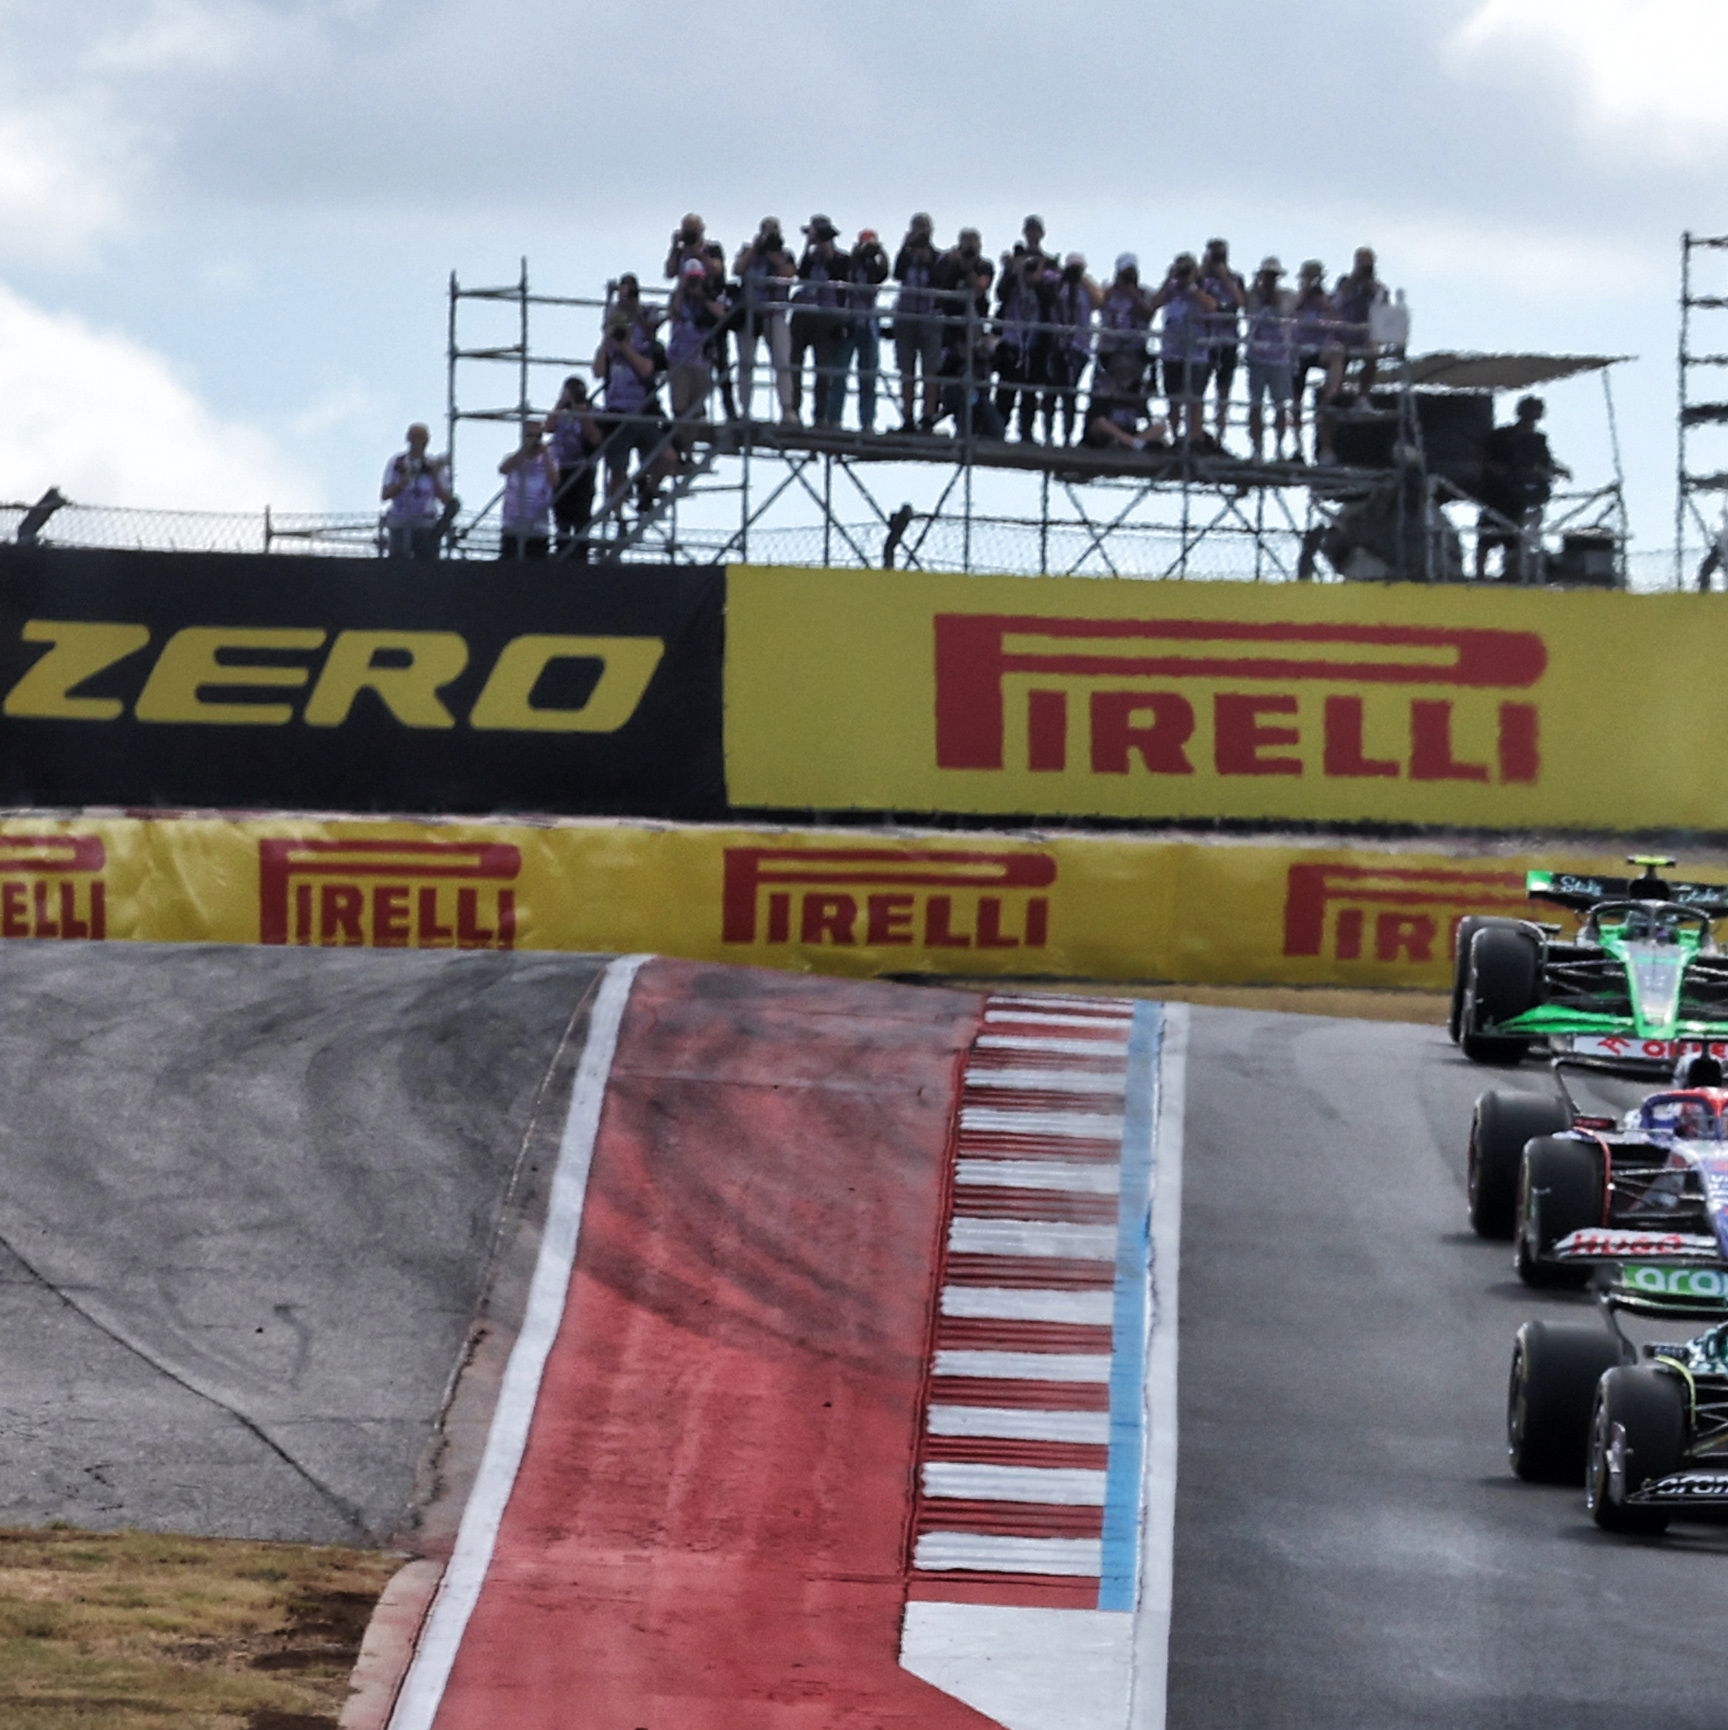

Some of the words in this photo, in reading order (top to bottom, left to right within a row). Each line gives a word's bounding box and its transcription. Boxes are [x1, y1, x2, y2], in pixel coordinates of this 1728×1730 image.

[3, 620, 665, 733] ZERO
[934, 613, 1547, 783] PIRELLI
[0, 835, 106, 940] ELLI
[260, 839, 521, 947] PIRELLI
[722, 847, 1057, 948] PIRELLI
